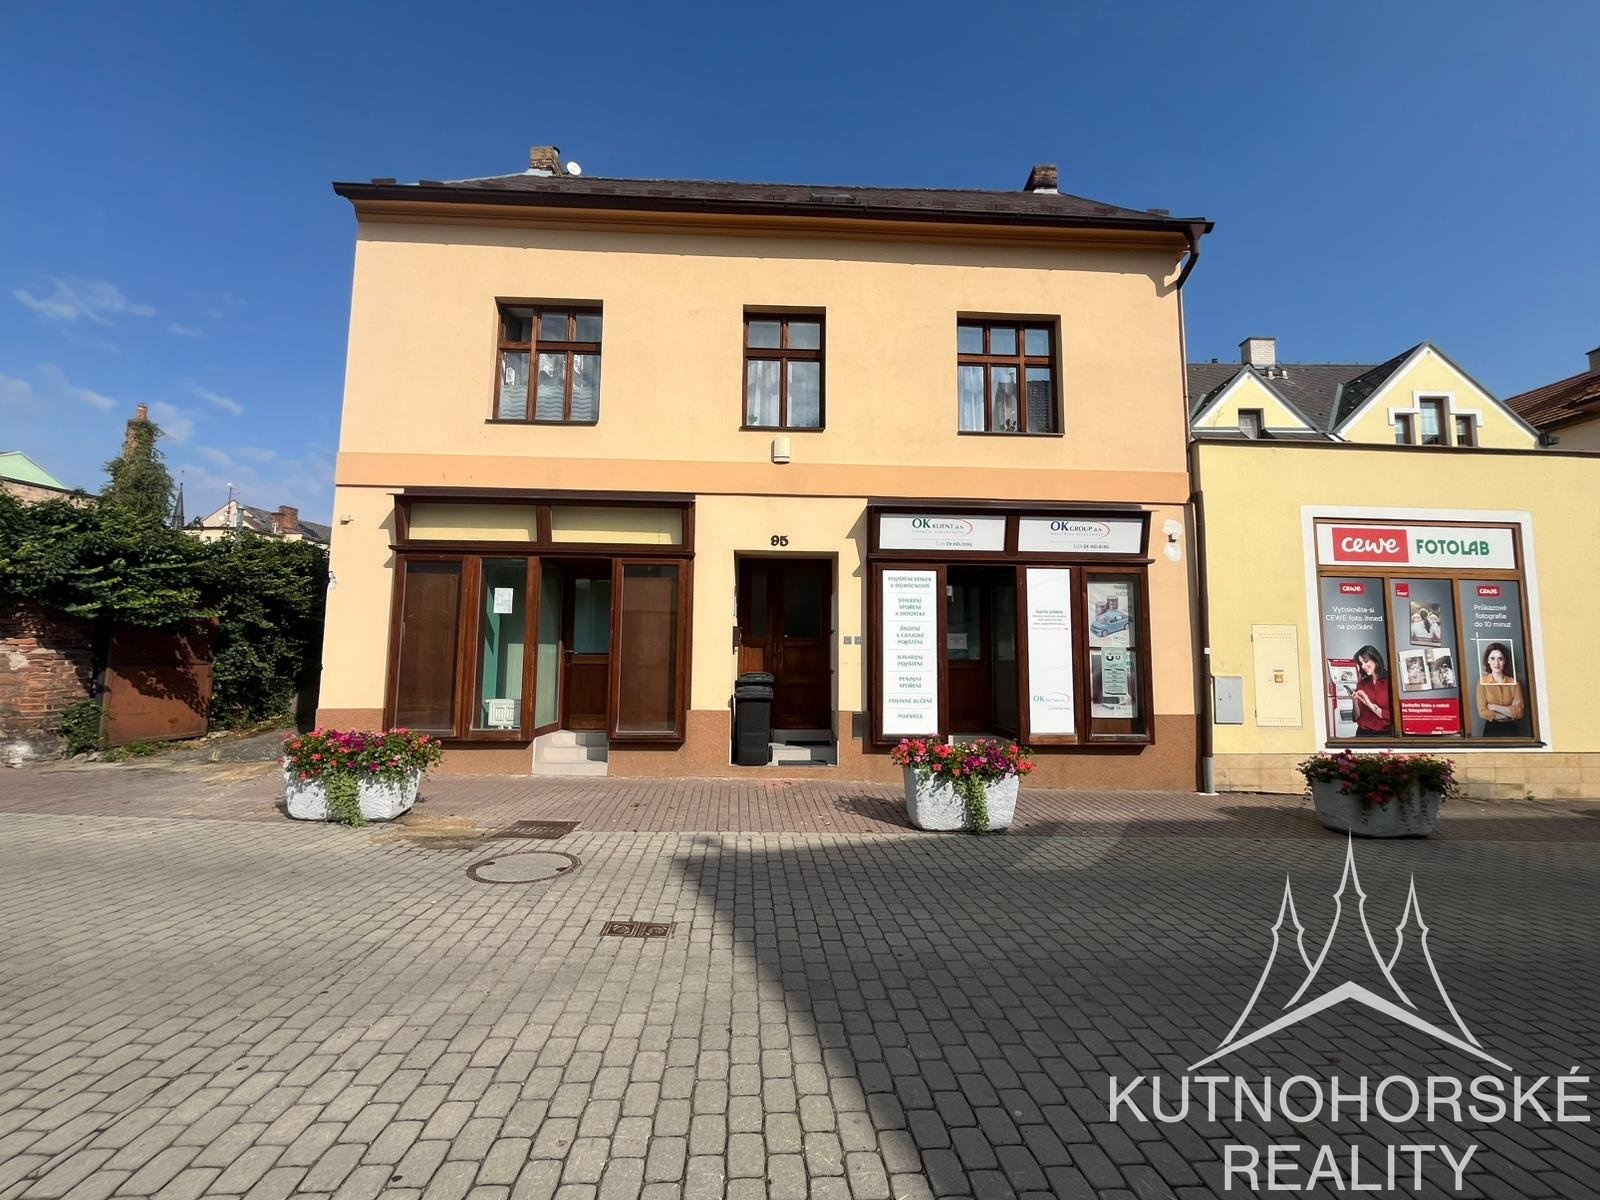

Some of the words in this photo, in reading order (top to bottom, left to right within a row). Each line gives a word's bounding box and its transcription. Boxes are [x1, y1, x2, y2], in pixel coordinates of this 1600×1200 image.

[911, 517, 931, 529] OK
[1050, 520, 1069, 531] OK
[770, 534, 789, 547] 95
[1416, 539, 1490, 556] FOTOLAB
[1475, 612, 1508, 620] fotografie
[1346, 623, 1374, 631] počkání
[1033, 695, 1045, 703] OK
